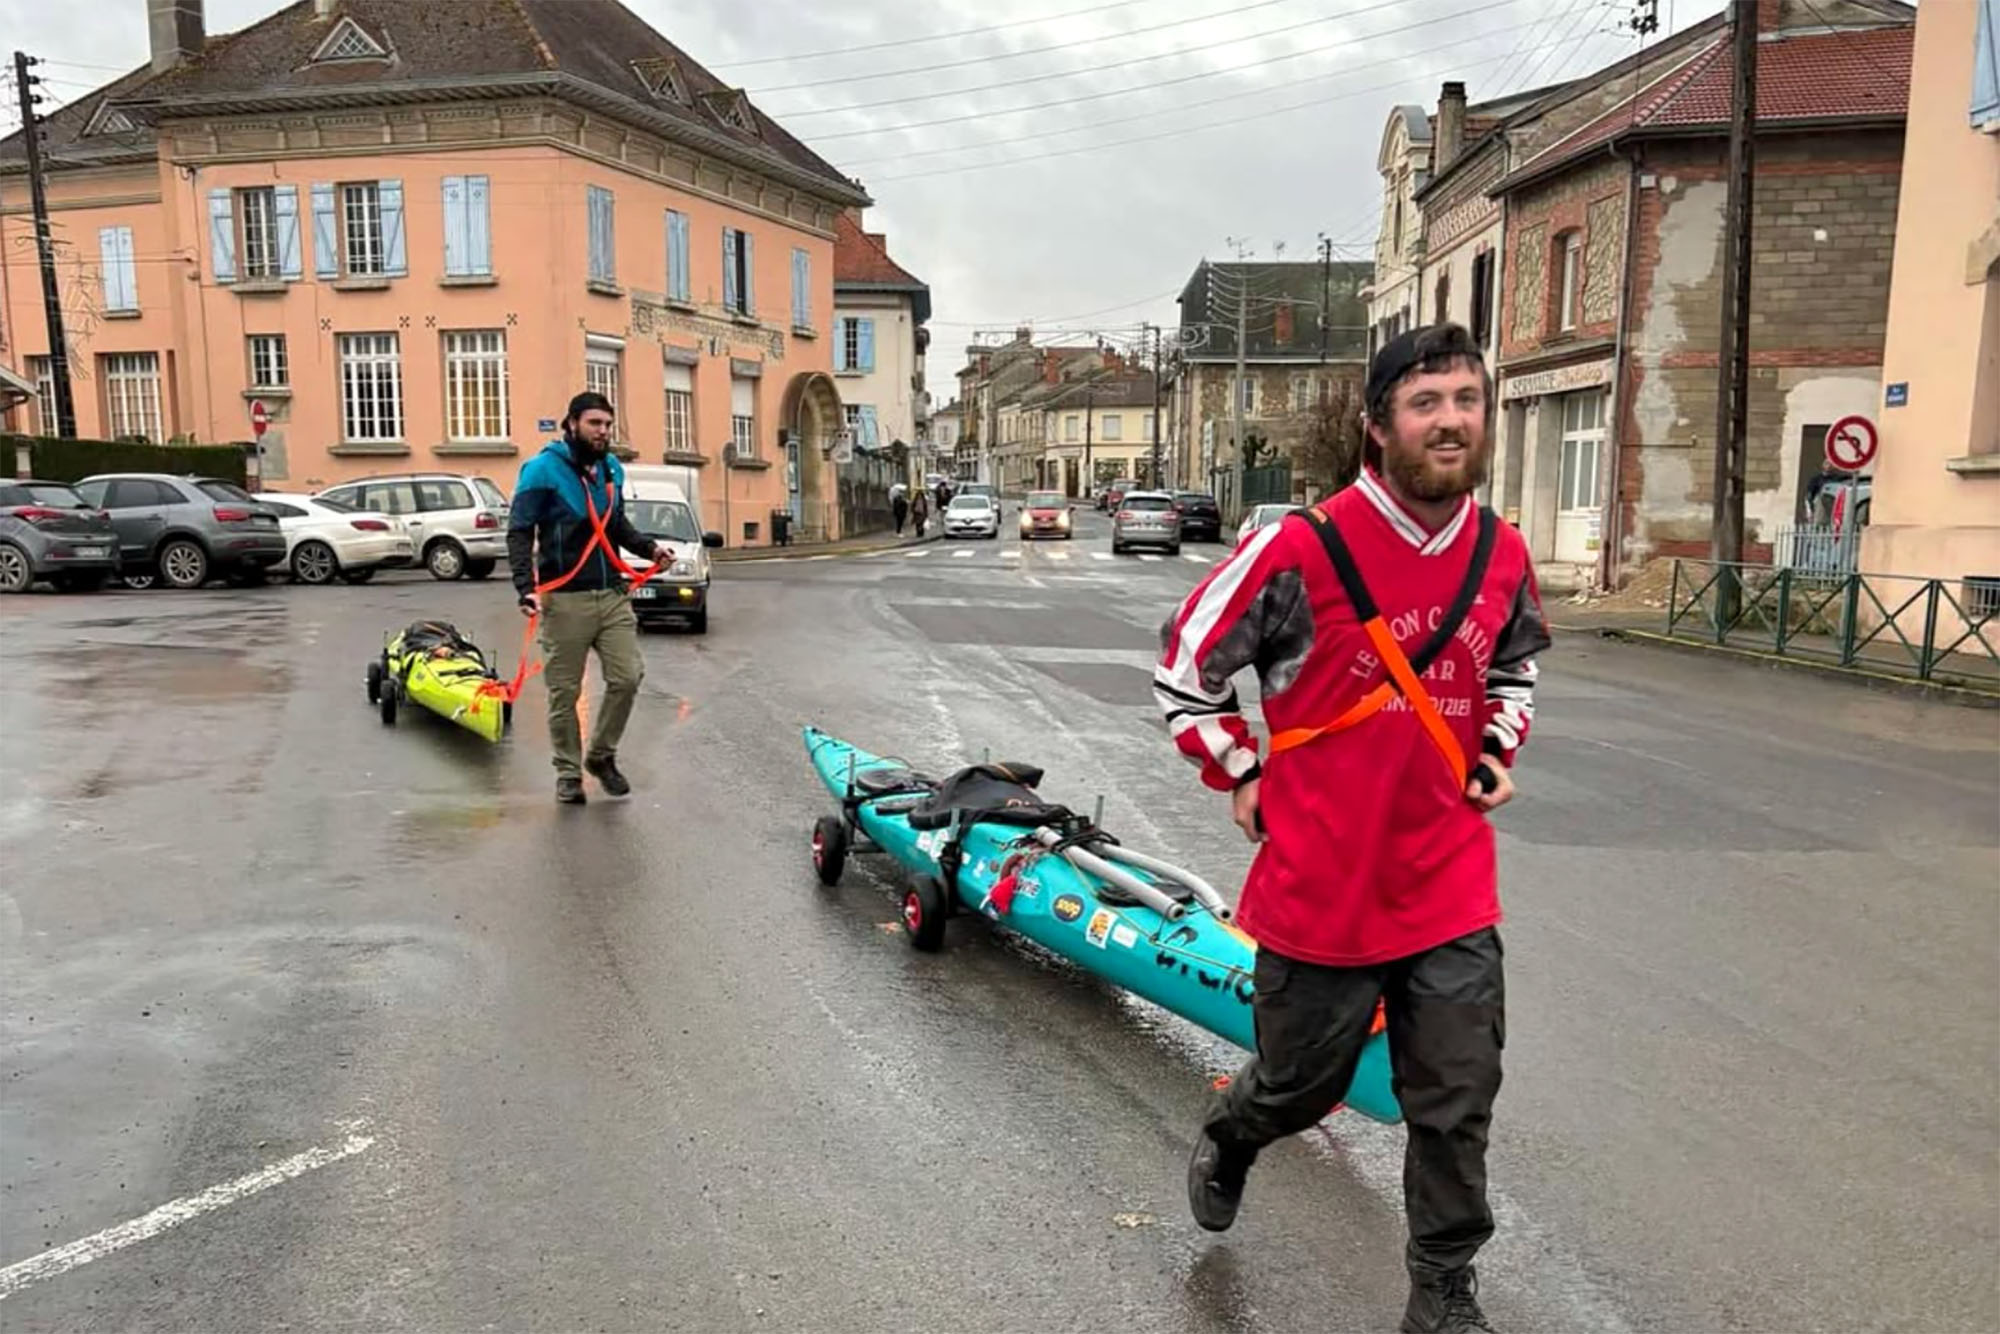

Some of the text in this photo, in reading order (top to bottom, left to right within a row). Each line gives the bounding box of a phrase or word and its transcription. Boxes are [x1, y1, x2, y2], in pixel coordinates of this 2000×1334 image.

[1350, 605, 1490, 683] LE ON CMILLO
[1419, 659, 1456, 681] AR
